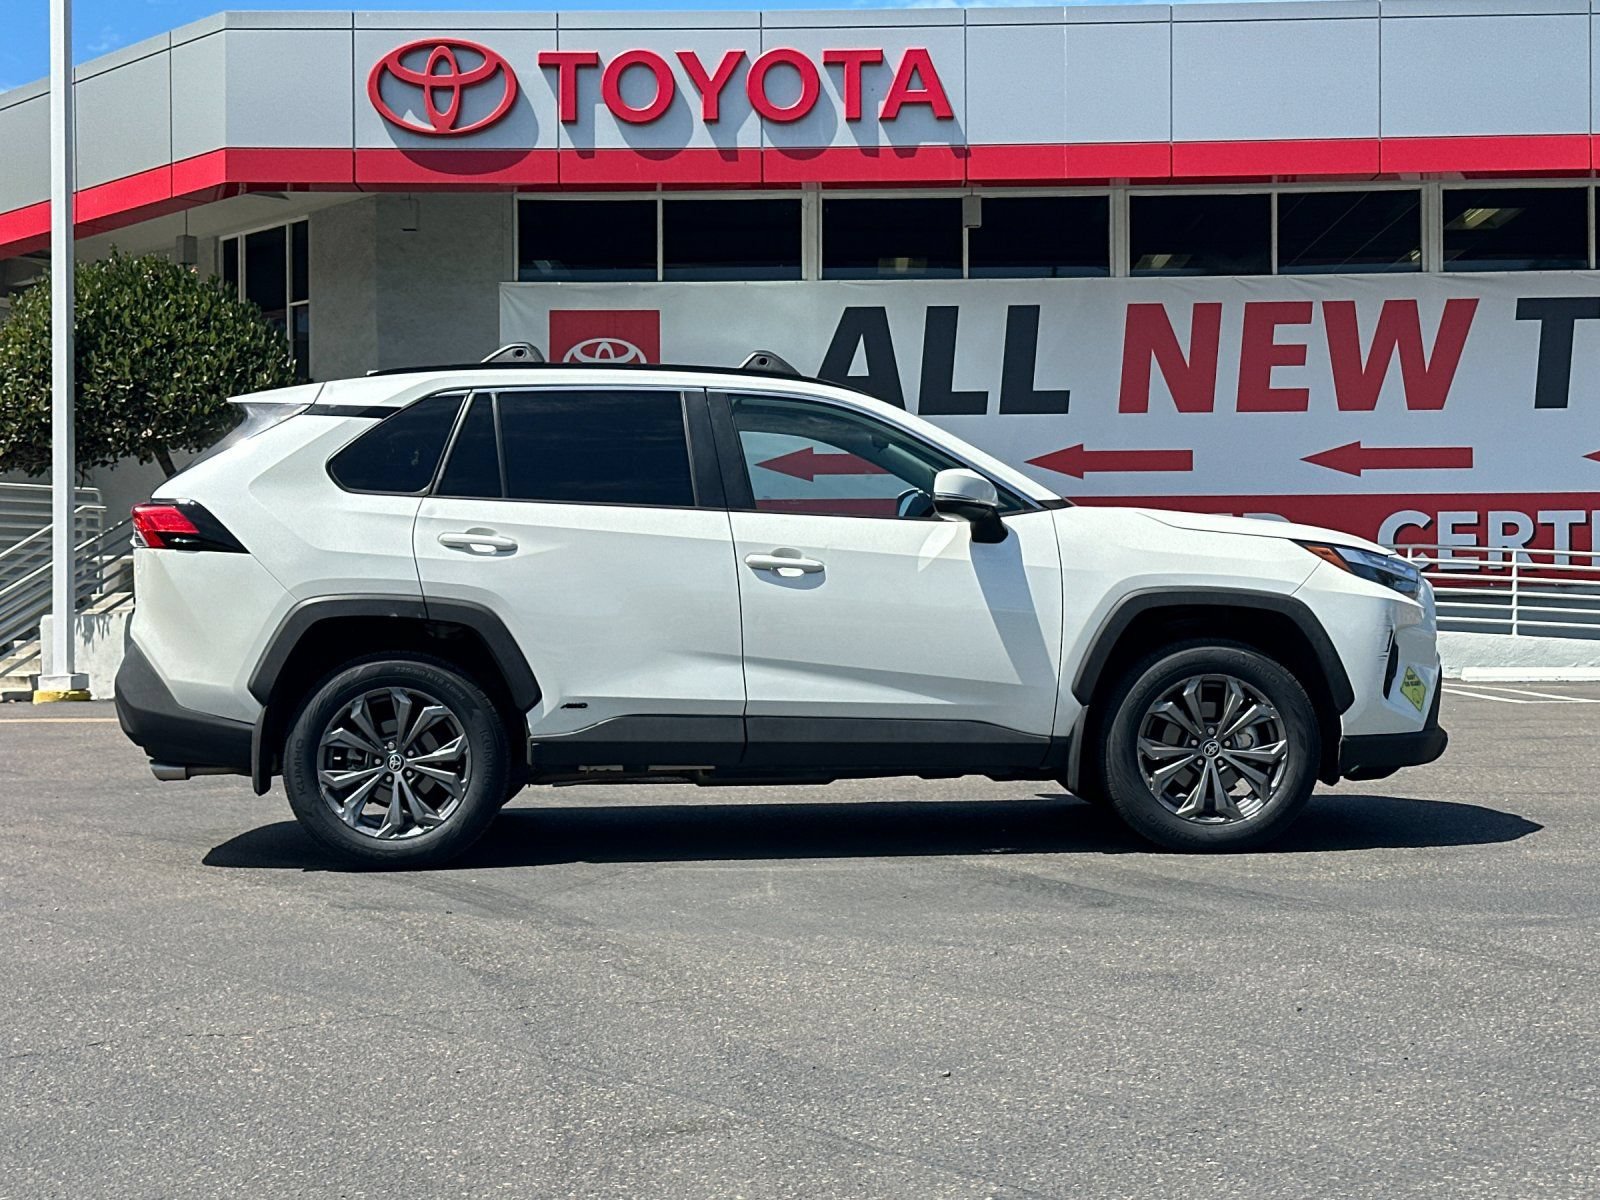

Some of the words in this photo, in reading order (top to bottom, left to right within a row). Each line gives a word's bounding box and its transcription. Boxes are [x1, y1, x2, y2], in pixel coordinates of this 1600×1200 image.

[538, 48, 954, 124] TOYOTA
[816, 305, 1070, 415] ALL
[1118, 298, 1480, 413] NEW
[1515, 297, 1600, 409] T
